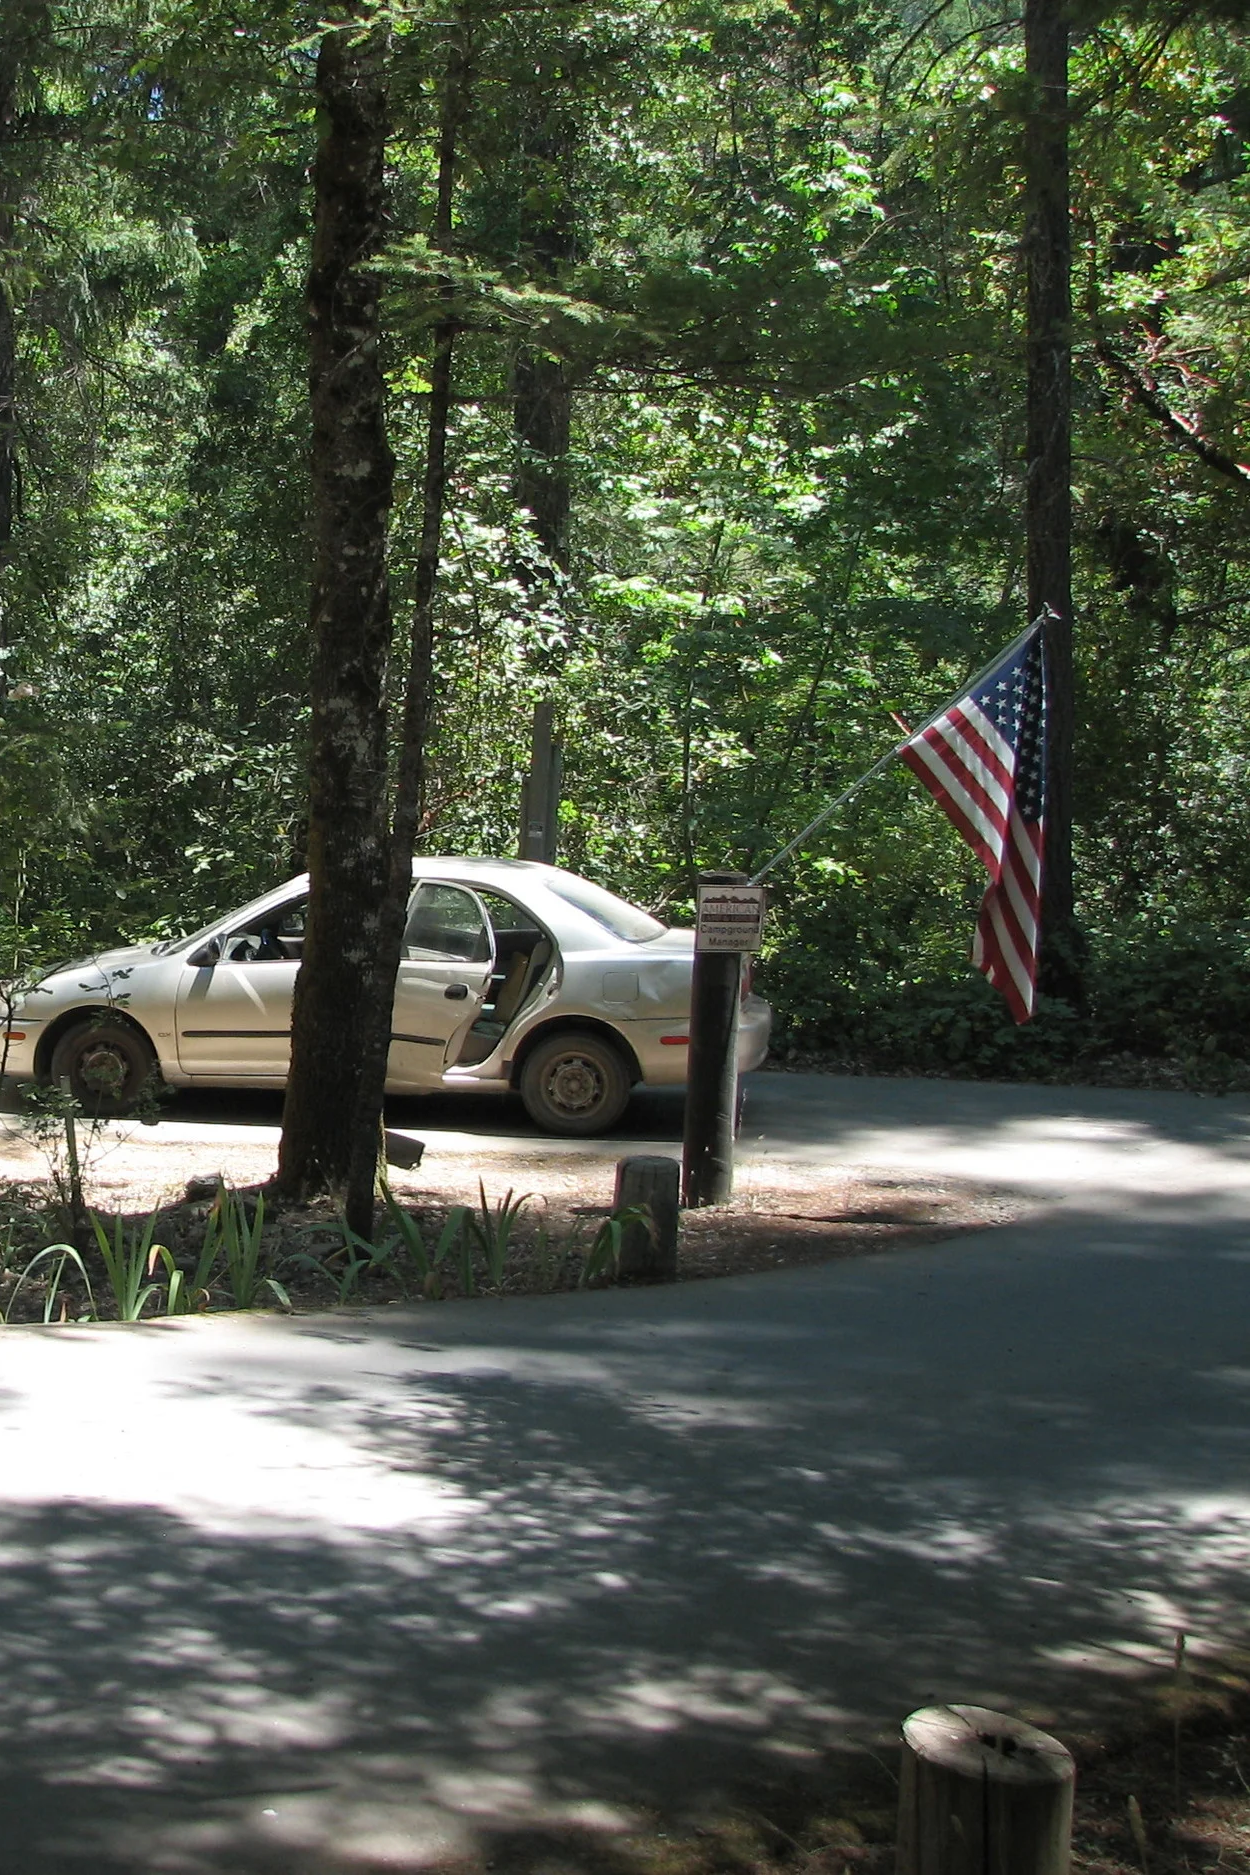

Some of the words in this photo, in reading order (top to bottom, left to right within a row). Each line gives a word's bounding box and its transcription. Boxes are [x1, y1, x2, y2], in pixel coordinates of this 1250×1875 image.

[702, 903, 760, 914] AMERICAN
[701, 924, 759, 935] Campground
[709, 937, 748, 948] Manager
